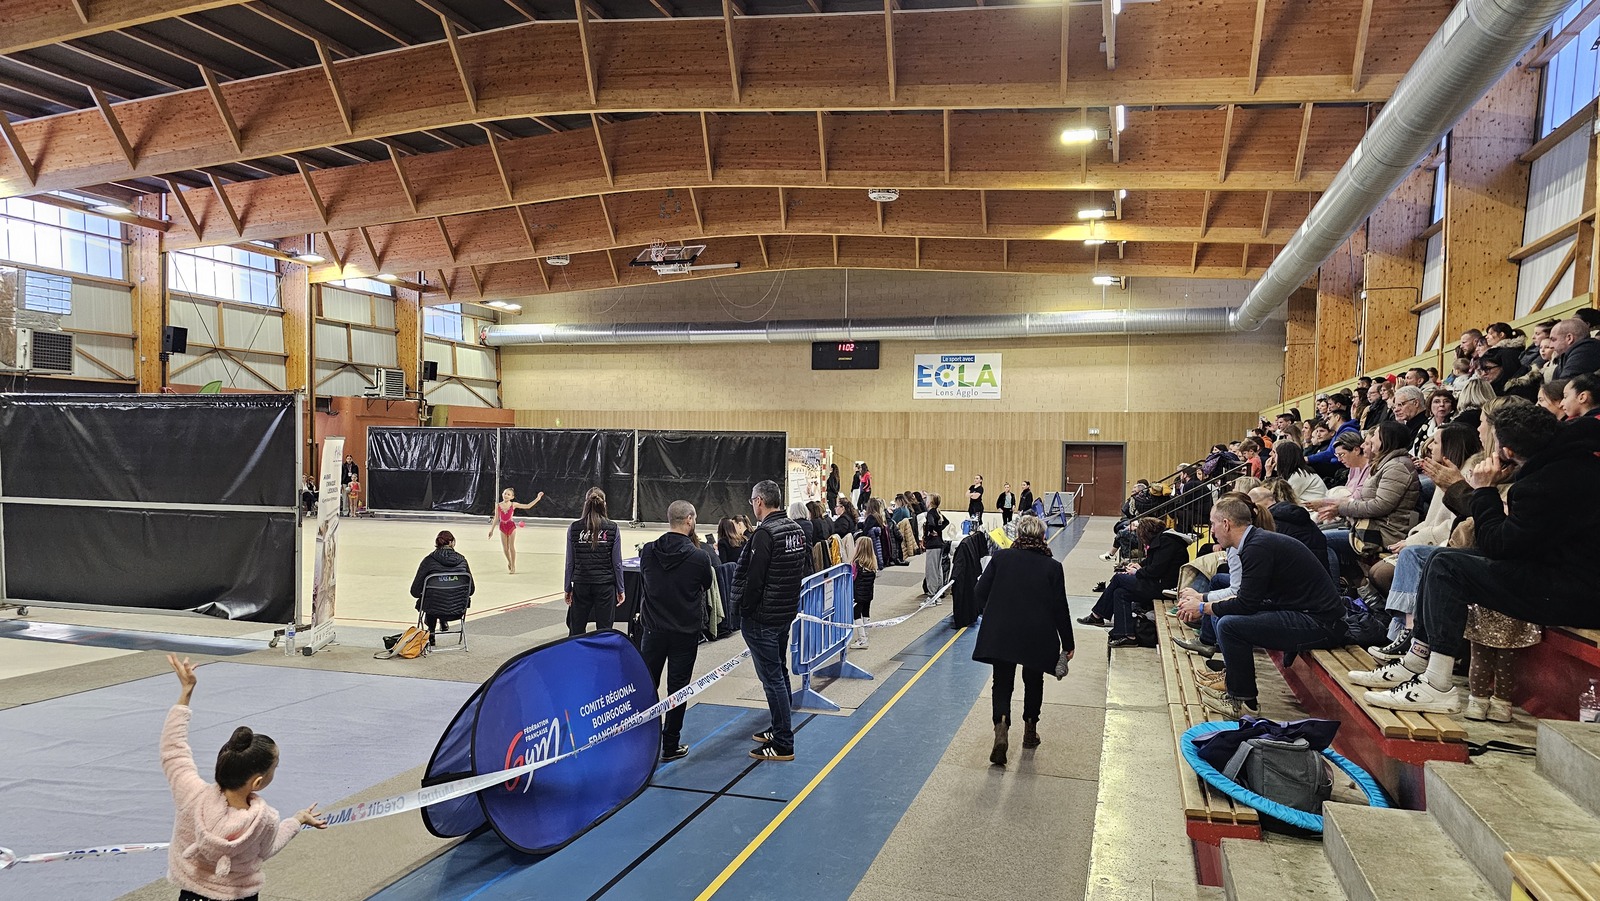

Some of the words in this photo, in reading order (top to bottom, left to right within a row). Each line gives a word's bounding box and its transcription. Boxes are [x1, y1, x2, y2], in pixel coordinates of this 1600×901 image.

[950, 355, 962, 363] sport
[917, 364, 998, 387] ECLA
[956, 389, 979, 398] Agglo
[580, 695, 605, 717] COMITÉ
[605, 683, 636, 705] RÉGIONAL
[592, 701, 632, 729] BOURGOGNE
[523, 718, 549, 735] FÉDÉRATION
[525, 727, 549, 742] FRANÇAISE
